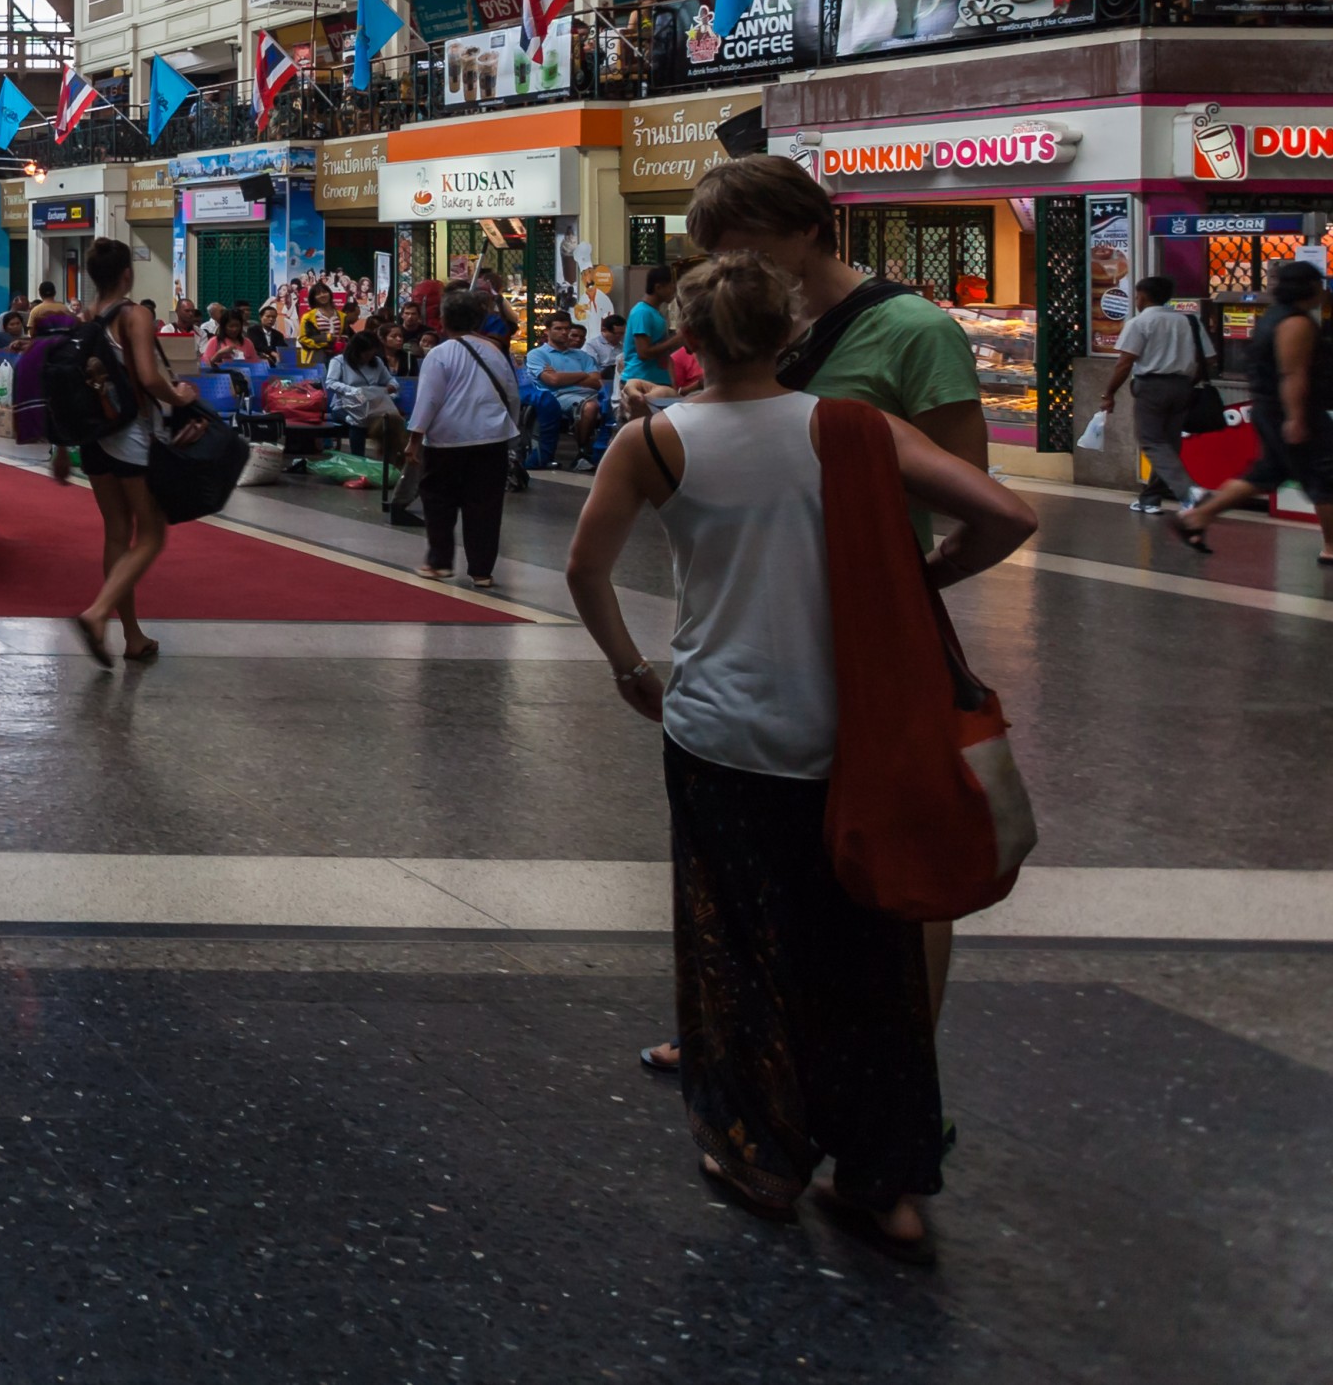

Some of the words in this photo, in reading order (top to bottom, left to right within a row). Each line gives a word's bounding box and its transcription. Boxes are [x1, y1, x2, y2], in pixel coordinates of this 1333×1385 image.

[723, 34, 794, 60] COFFEE
[688, 68, 693, 76] A
[706, 65, 719, 74] from
[824, 143, 929, 175] DUNKIN'
[935, 131, 1056, 167] DONUTS
[1215, 150, 1230, 162] DD
[633, 157, 695, 181] Grocery
[442, 169, 515, 193] KUDSAN
[322, 181, 359, 201] Grocery
[362, 180, 379, 196] sho
[477, 195, 483, 207] &
[487, 192, 515, 207] Coffee
[1196, 218, 1265, 232] POPCORN
[1094, 239, 1128, 248] DONUTS
